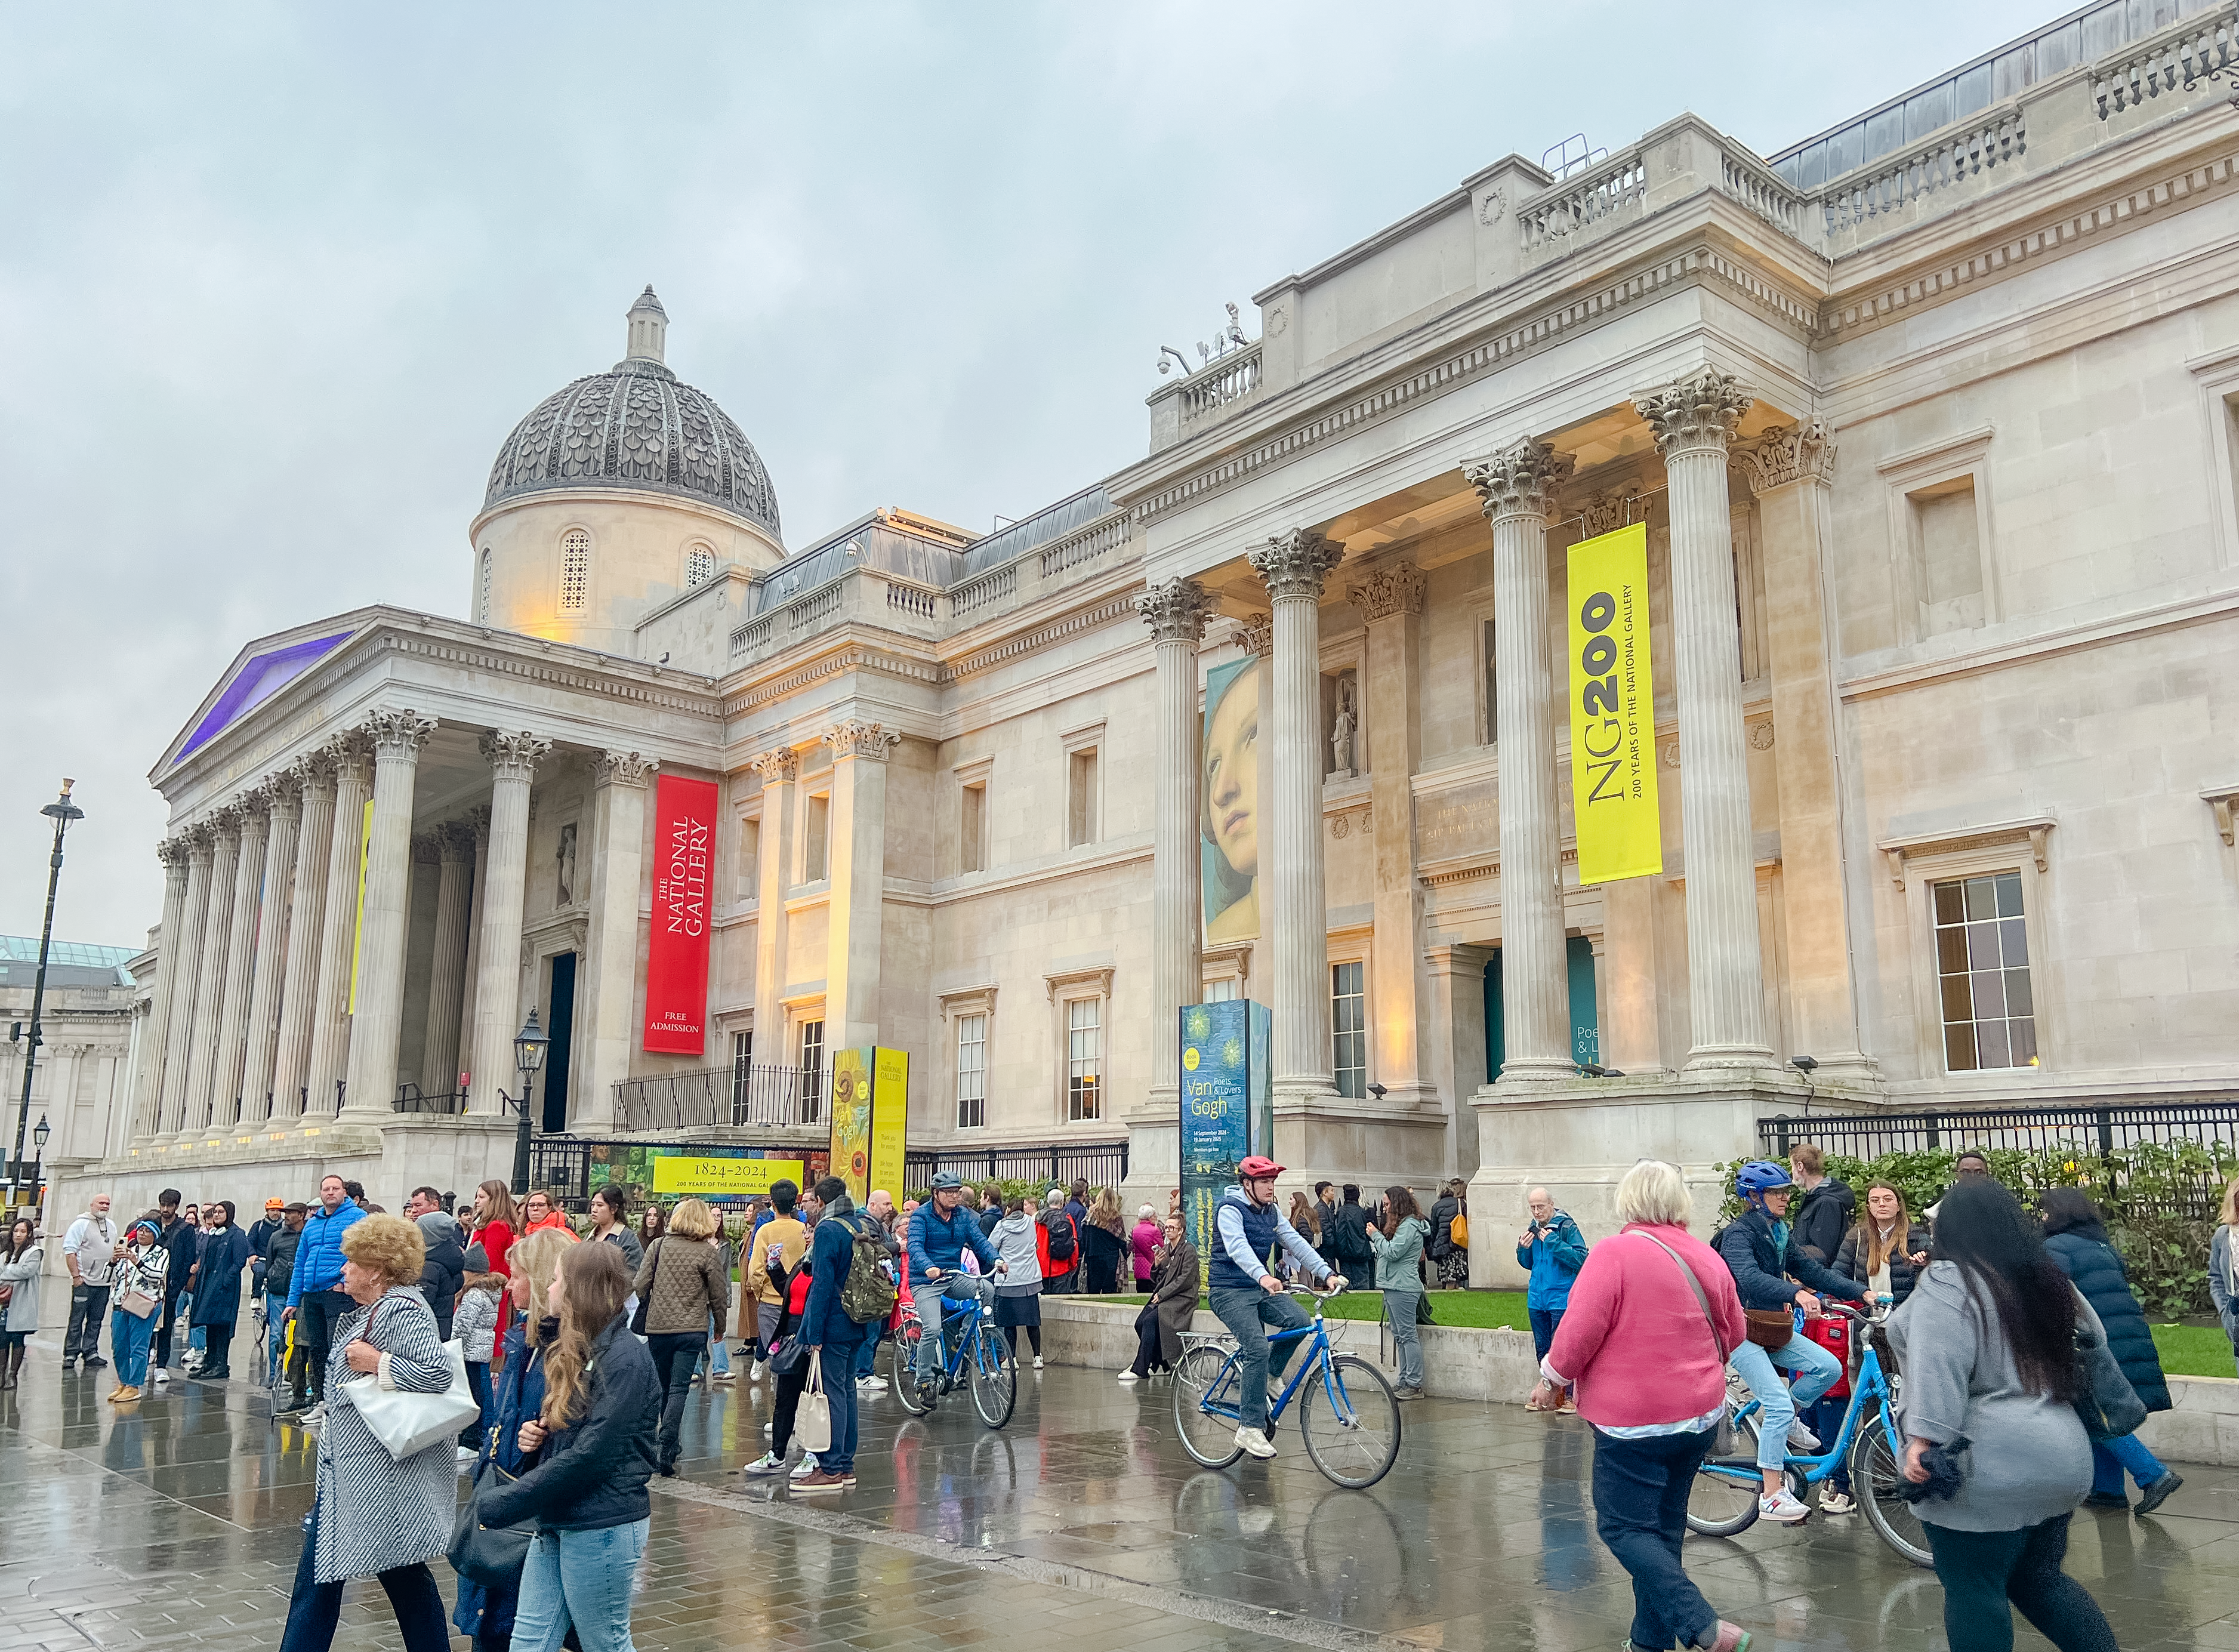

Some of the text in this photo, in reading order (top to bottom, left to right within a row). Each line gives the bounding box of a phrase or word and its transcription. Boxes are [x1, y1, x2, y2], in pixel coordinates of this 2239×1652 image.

[1581, 591, 1625, 807] NG200
[1623, 584, 1642, 800] 200 YEARS OF THE NATIONAL GALLERY
[1437, 797, 1499, 820] THE NATIO
[667, 815, 689, 935] NATIONAL
[685, 816, 708, 937] GALLERY
[658, 877, 668, 902] THE
[665, 1011, 687, 1021] FREE
[650, 1021, 699, 1033] ADMISSION
[1577, 1027, 1598, 1039] Poe
[1578, 1041, 1587, 1053] &
[880, 1064, 902, 1074] NATIONAL
[880, 1071, 902, 1082] GALLERY
[1186, 1079, 1212, 1096] Van
[1213, 1086, 1242, 1095] & Lovers
[835, 1108, 851, 1122] Van
[1191, 1096, 1228, 1120] Gogh
[837, 1121, 858, 1140] Gogh
